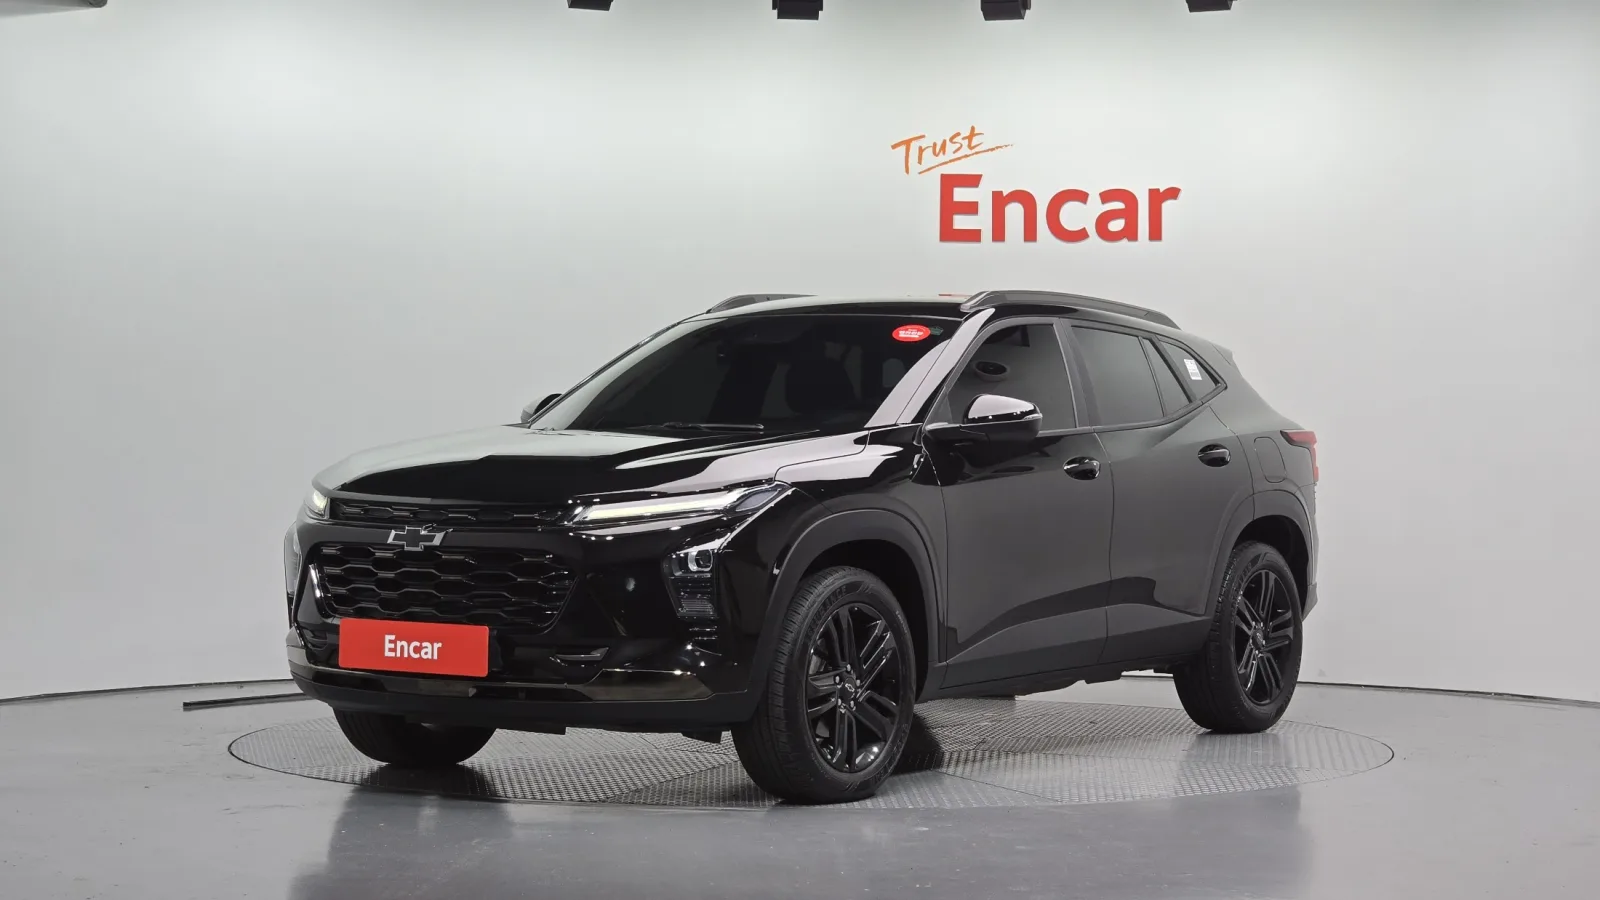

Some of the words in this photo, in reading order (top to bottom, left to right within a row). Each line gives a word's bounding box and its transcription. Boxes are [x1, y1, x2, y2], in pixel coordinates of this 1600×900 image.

[891, 125, 984, 174] Trust
[939, 173, 1182, 243] Encar
[384, 634, 443, 660] Encar
